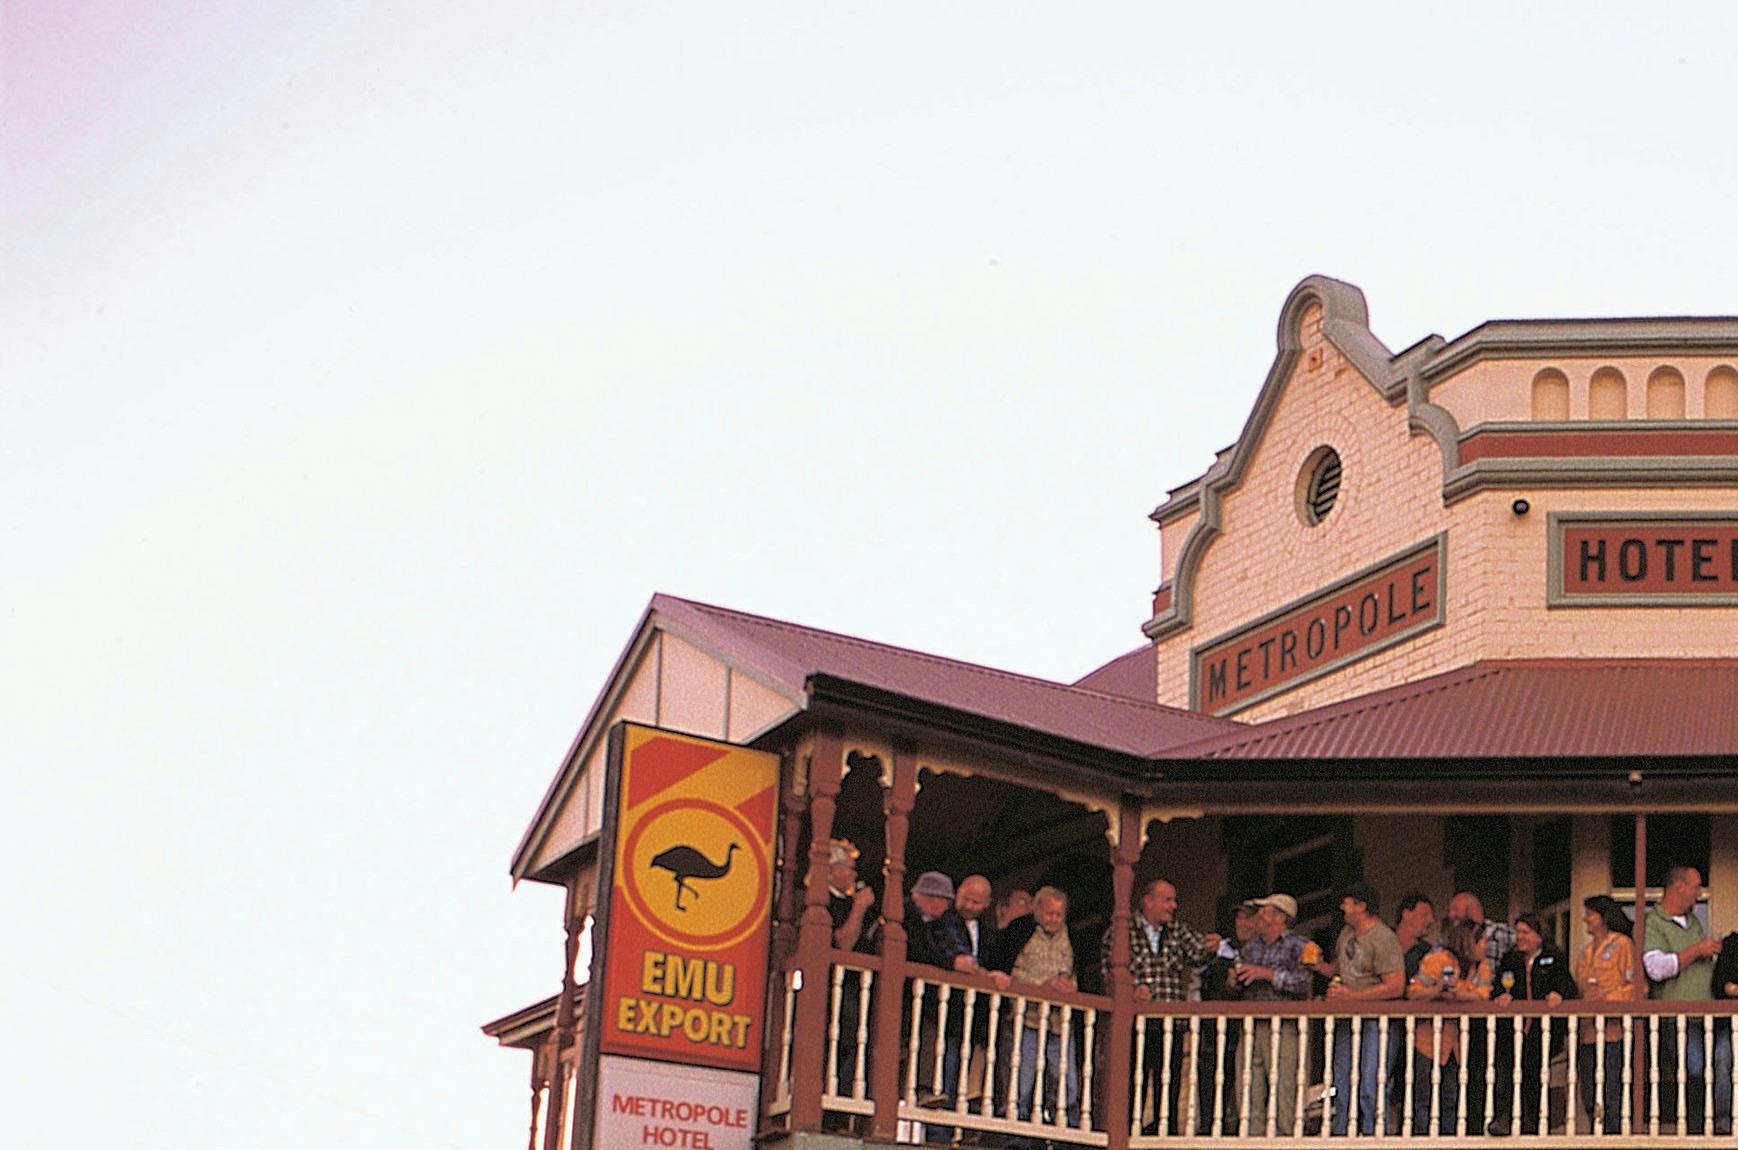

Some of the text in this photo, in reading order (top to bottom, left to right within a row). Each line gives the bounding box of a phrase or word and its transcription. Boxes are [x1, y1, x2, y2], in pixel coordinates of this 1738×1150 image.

[1208, 567, 1431, 703] METROPOLE
[642, 950, 735, 1006] EMU
[617, 997, 751, 1048] EXPORT
[613, 1094, 748, 1128] METROPOLE
[643, 1125, 714, 1150] HOTEL
